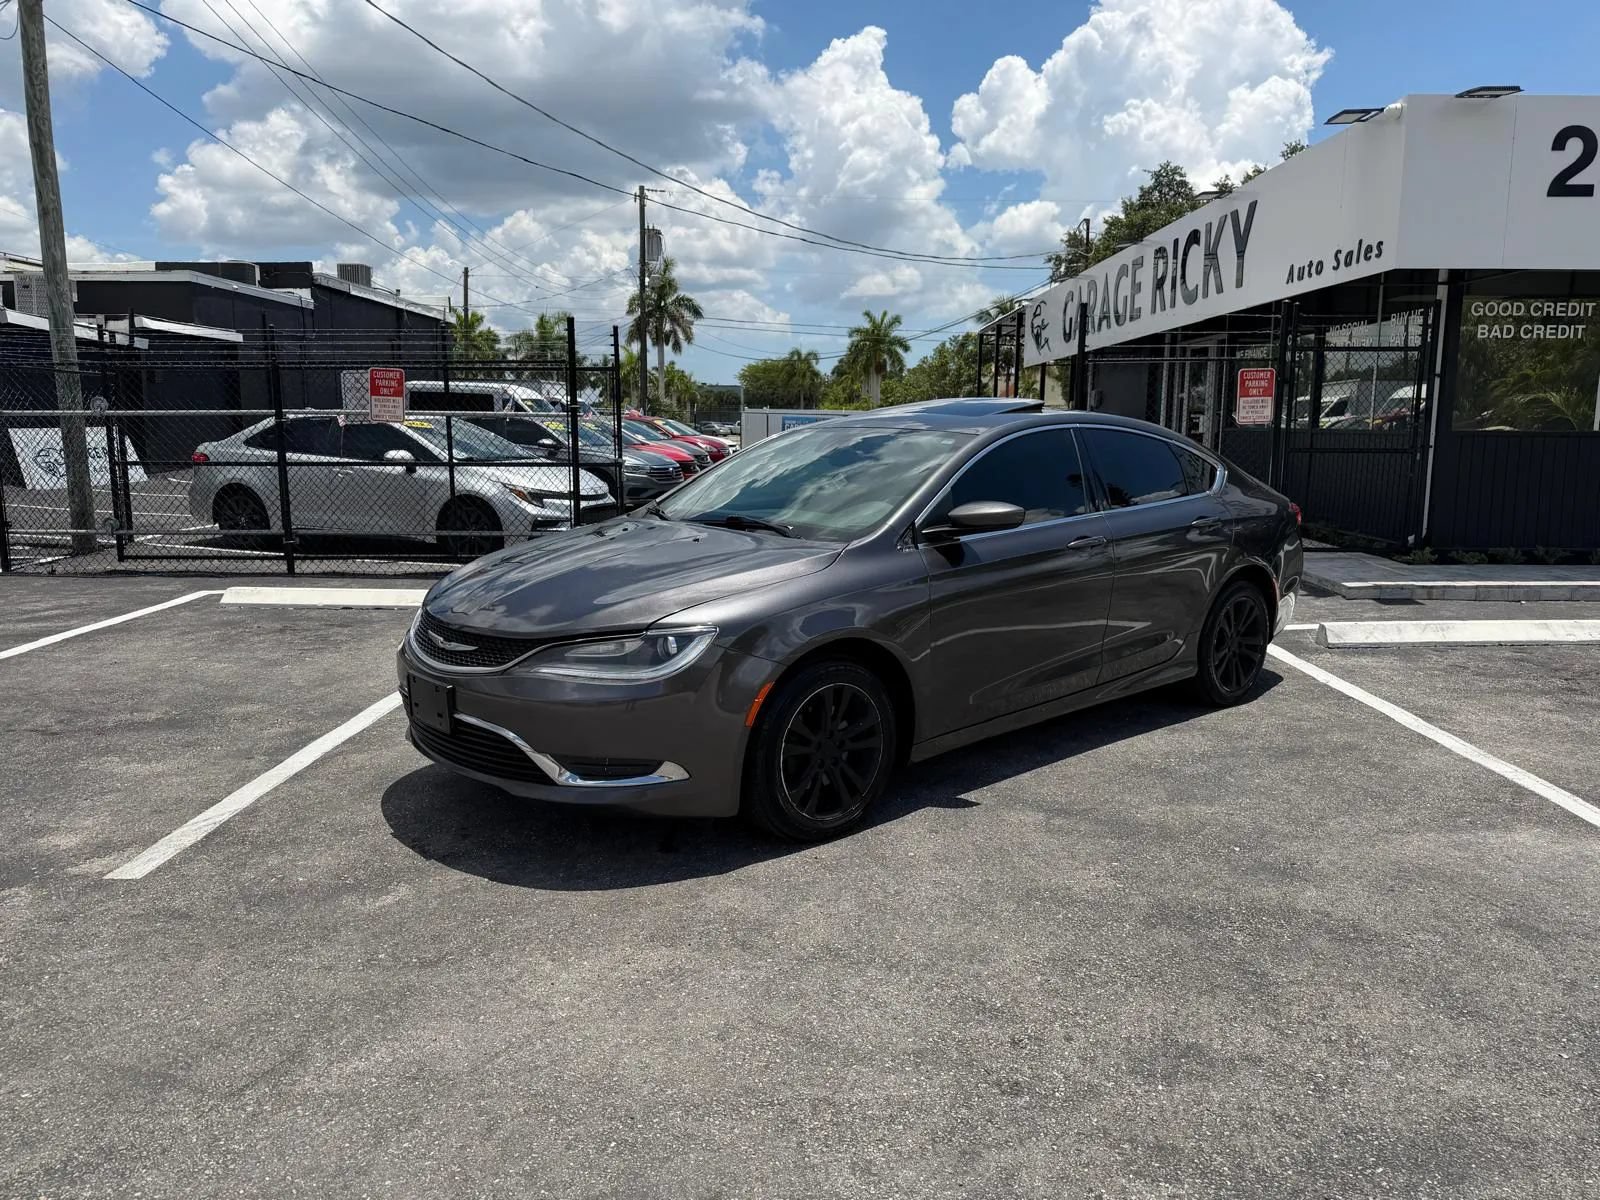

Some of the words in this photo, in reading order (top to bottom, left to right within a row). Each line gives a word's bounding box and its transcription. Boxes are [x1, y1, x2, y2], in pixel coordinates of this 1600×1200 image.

[1546, 124, 1599, 198] 2
[1285, 260, 1324, 285] Auto
[1332, 238, 1384, 271] Sales
[1062, 255, 1144, 344] GARAGE
[1150, 199, 1258, 315] RICKY
[1470, 301, 1525, 317] GOOD
[1530, 301, 1597, 317] CREDIT
[1391, 311, 1409, 328] BUY
[1477, 324, 1515, 339] BAD
[1520, 324, 1587, 339] CREDIT
[372, 370, 401, 379] CUSTOMER
[1243, 371, 1271, 380] CUSTOMER
[375, 379, 399, 387] PARKING
[1245, 379, 1269, 388] PARKING
[379, 387, 394, 395] ONLY
[1248, 388, 1264, 396] ONLY
